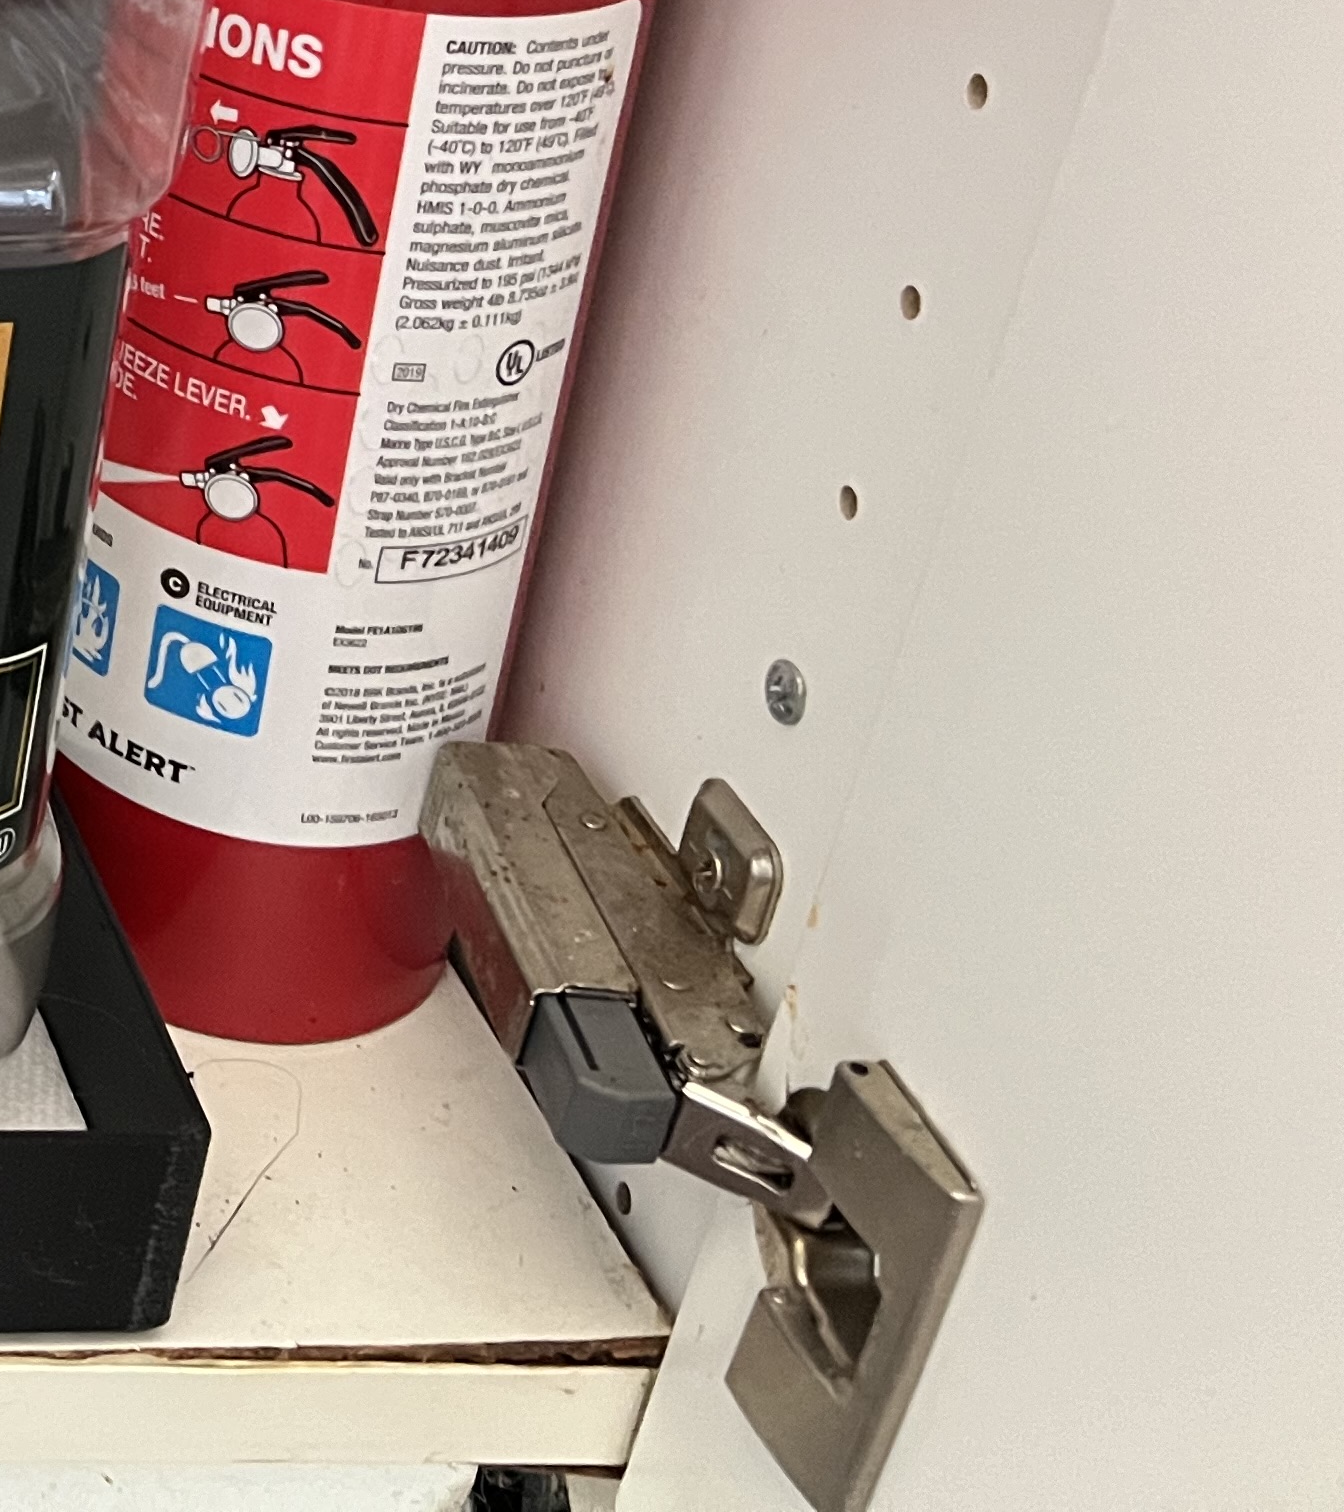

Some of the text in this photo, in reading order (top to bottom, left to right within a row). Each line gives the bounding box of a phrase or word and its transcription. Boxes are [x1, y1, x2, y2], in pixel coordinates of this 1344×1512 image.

[446, 39, 578, 55] CAUTION: Contents
[442, 59, 554, 76] pressure. Do not
[438, 79, 556, 95] incinerate. Do not
[436, 100, 557, 116] temperatures over
[431, 120, 536, 135] Suitable for use
[480, 142, 493, 154] to
[425, 162, 454, 174] with
[460, 161, 482, 174] WY
[420, 181, 517, 195] phosphate dry
[417, 201, 453, 214] HMIS
[410, 240, 489, 255] magnesium
[406, 258, 469, 272] Nuisance
[403, 277, 492, 290] Pressurized to
[400, 295, 484, 311] Gross weight
[396, 366, 422, 378] 2019
[174, 372, 251, 420] LEVER.
[387, 402, 404, 415] Dry
[401, 525, 519, 569] F72341409
[198, 582, 278, 614] ELECTRICAL
[195, 596, 273, 626] EQUIPMENT
[87, 719, 188, 783] ALERT
